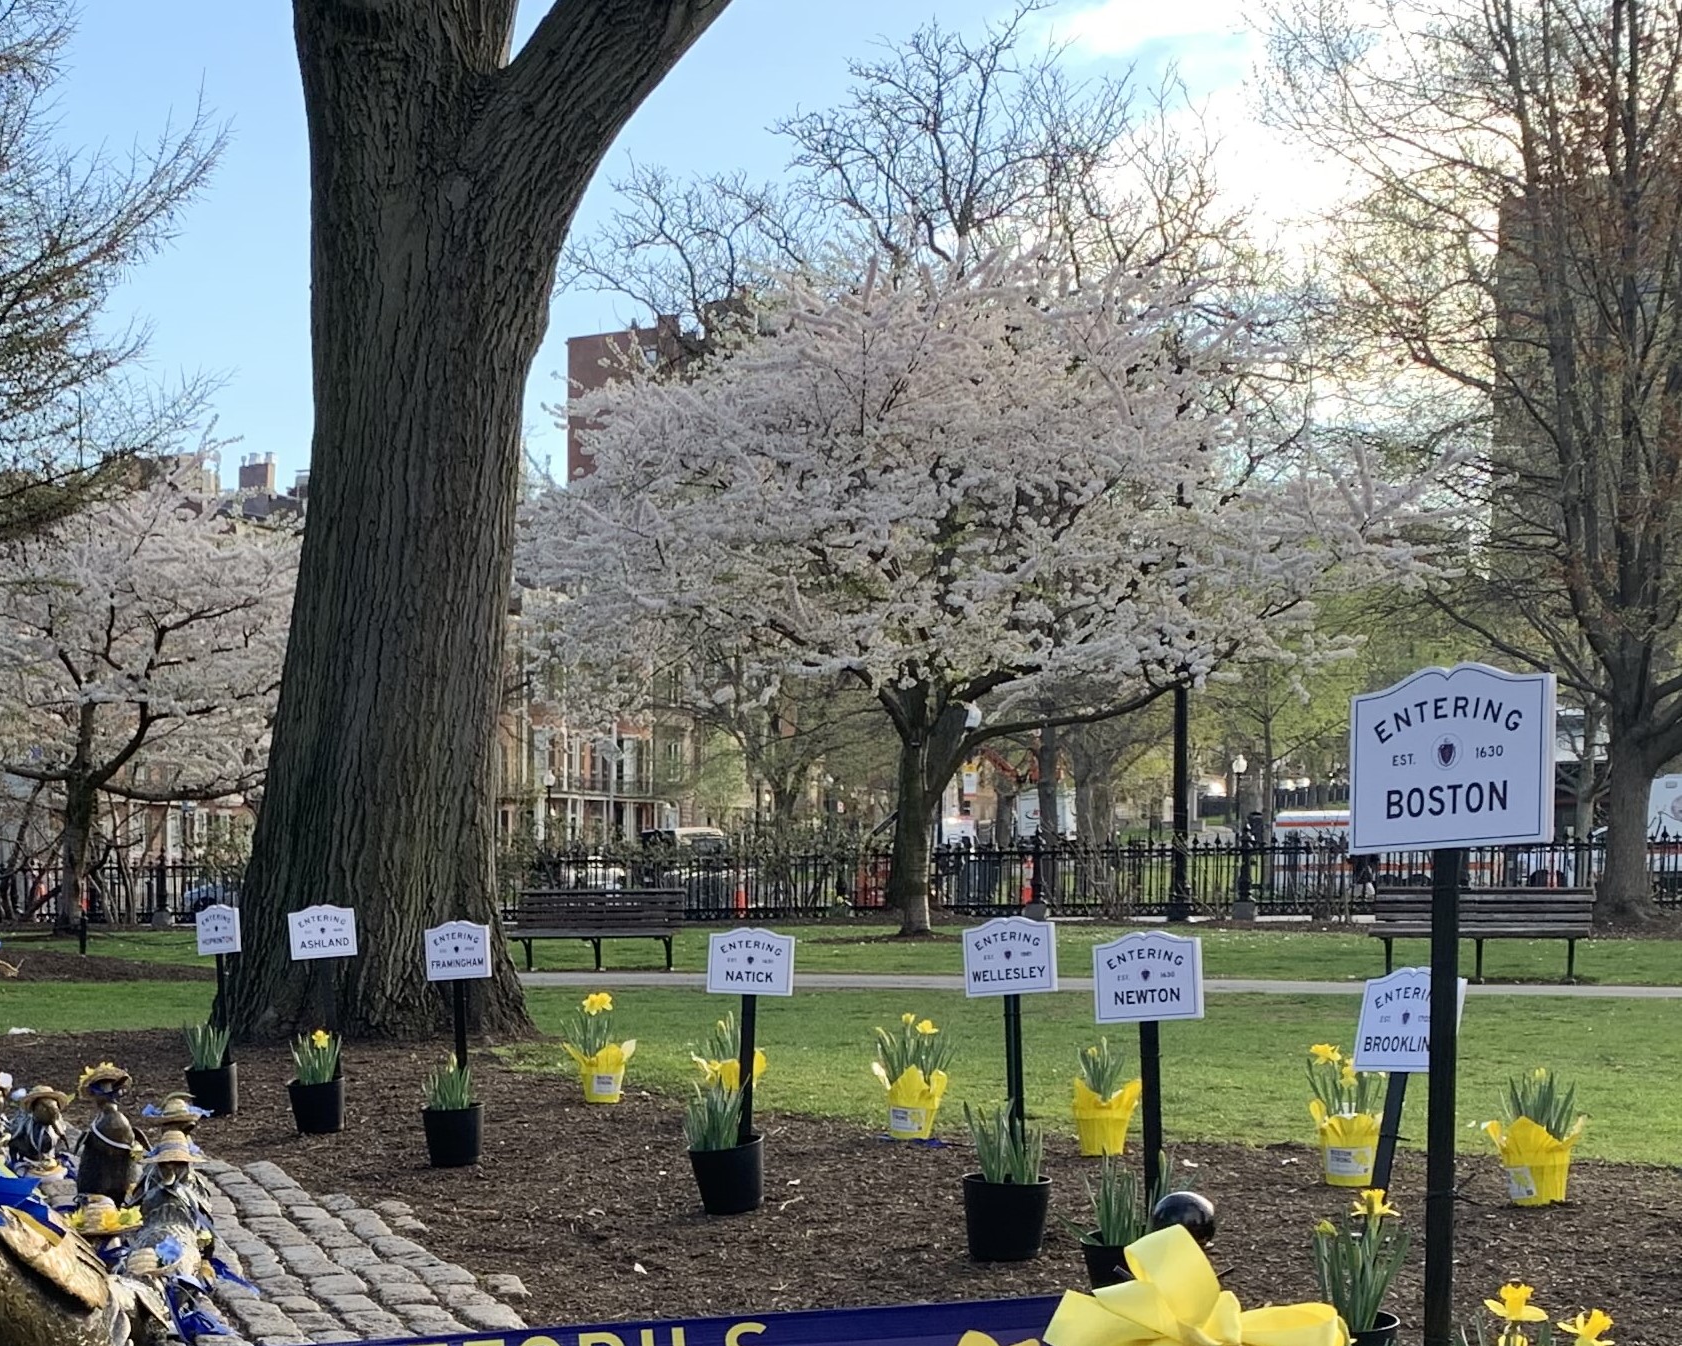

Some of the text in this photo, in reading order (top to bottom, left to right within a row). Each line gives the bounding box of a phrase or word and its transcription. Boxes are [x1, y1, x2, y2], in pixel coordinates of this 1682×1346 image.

[1373, 696, 1523, 744] ENTERING
[1392, 745, 1504, 767] EST. 1630
[1386, 780, 1508, 820] BOSTON
[297, 914, 347, 928] ENTERING
[300, 937, 350, 949] ASHLAND
[433, 932, 480, 946] ENTERING
[719, 940, 783, 956] ENTERING
[974, 931, 1041, 951] ENTERING
[431, 957, 484, 970] FRAMINGHAM
[1106, 948, 1185, 970] ENTERING
[725, 970, 774, 983] NATICK
[971, 965, 1046, 983] WELLESLEY
[1114, 987, 1180, 1005] NEWTON
[1374, 986, 1431, 1010] ENTERI
[1363, 1035, 1431, 1053] BROOKLIN
